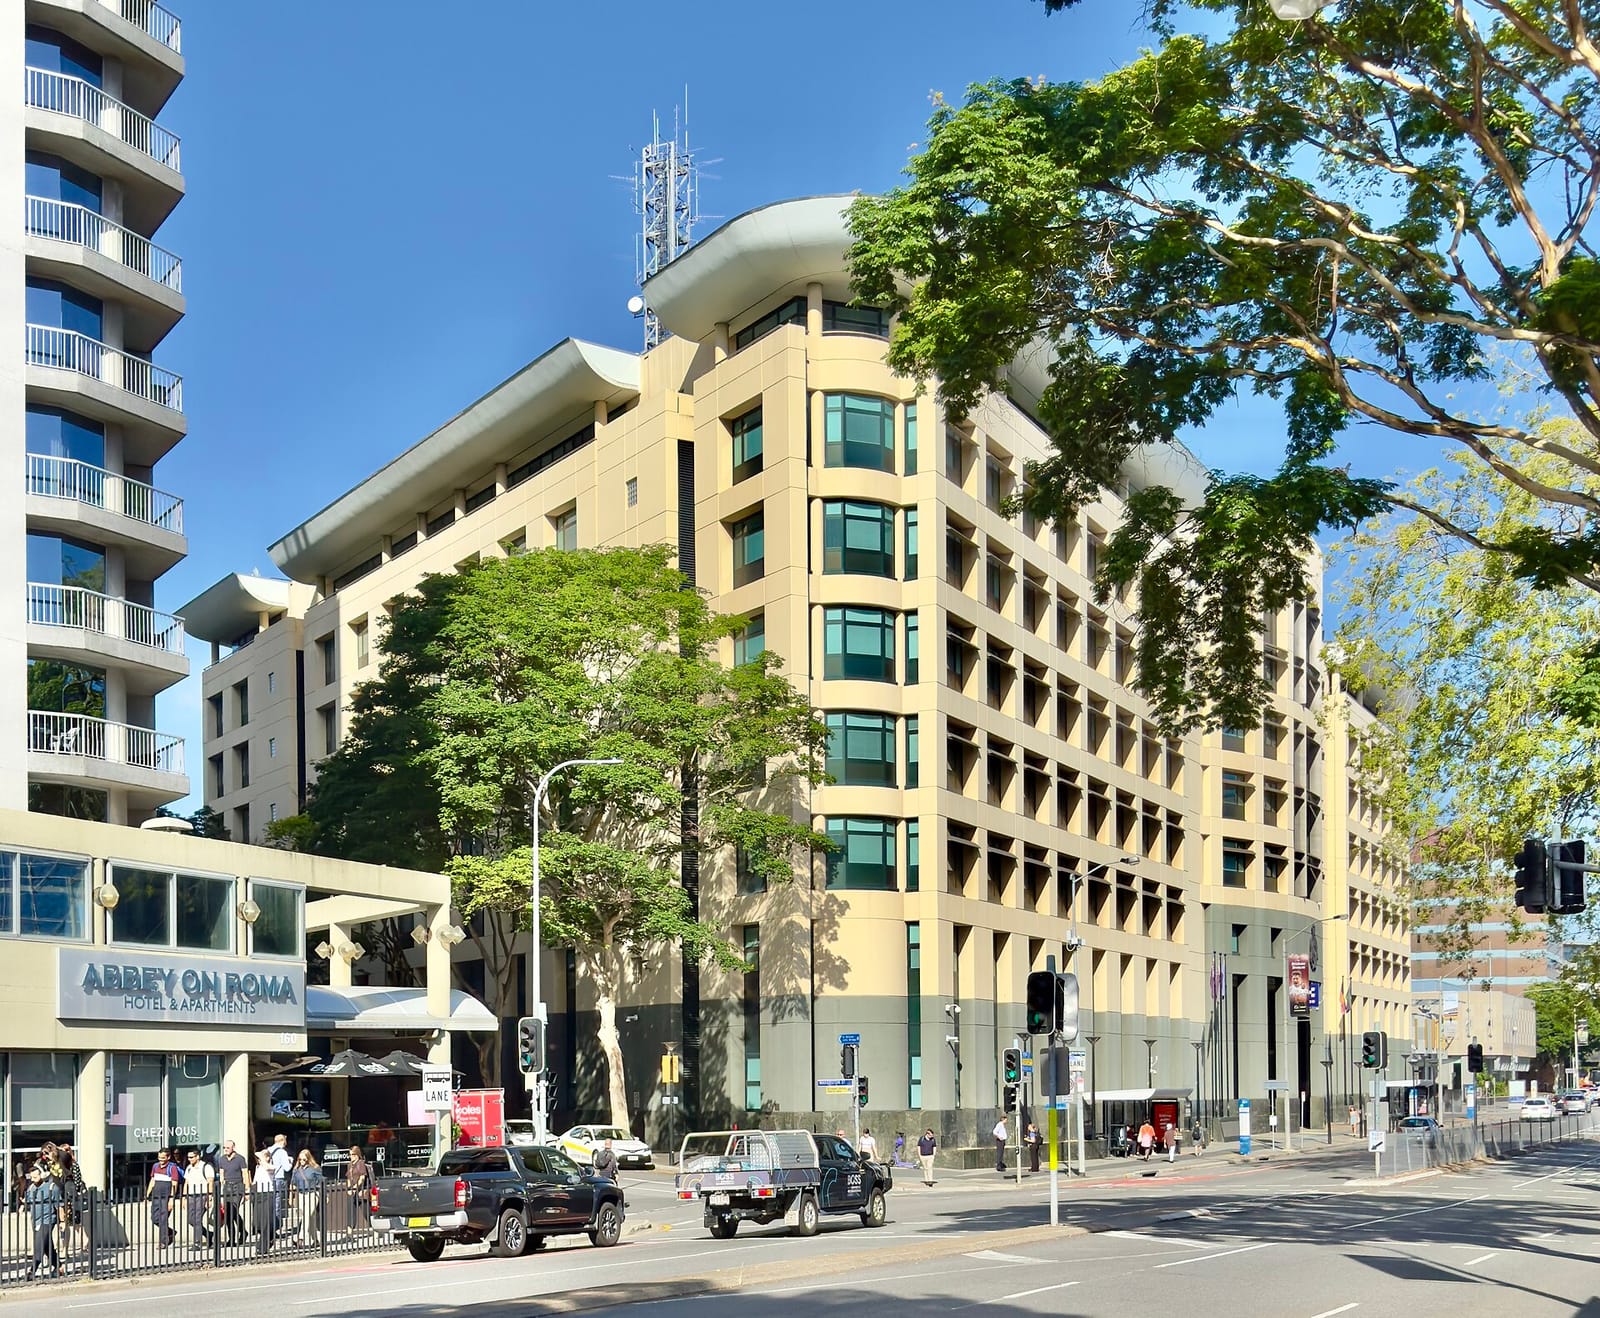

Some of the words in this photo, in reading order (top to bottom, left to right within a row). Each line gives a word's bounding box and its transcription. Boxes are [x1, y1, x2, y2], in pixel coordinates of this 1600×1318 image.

[81, 962, 176, 995] ABBEY
[181, 969, 222, 1001] ON
[225, 972, 298, 1005] ROMA
[124, 995, 166, 1011] HOTEL
[169, 999, 179, 1012] &
[180, 998, 256, 1014] APARTMENTS
[279, 1032, 297, 1046] 160
[425, 1089, 449, 1102] LANE
[133, 1127, 163, 1138] CHEZ
[166, 1126, 198, 1137] NOUS
